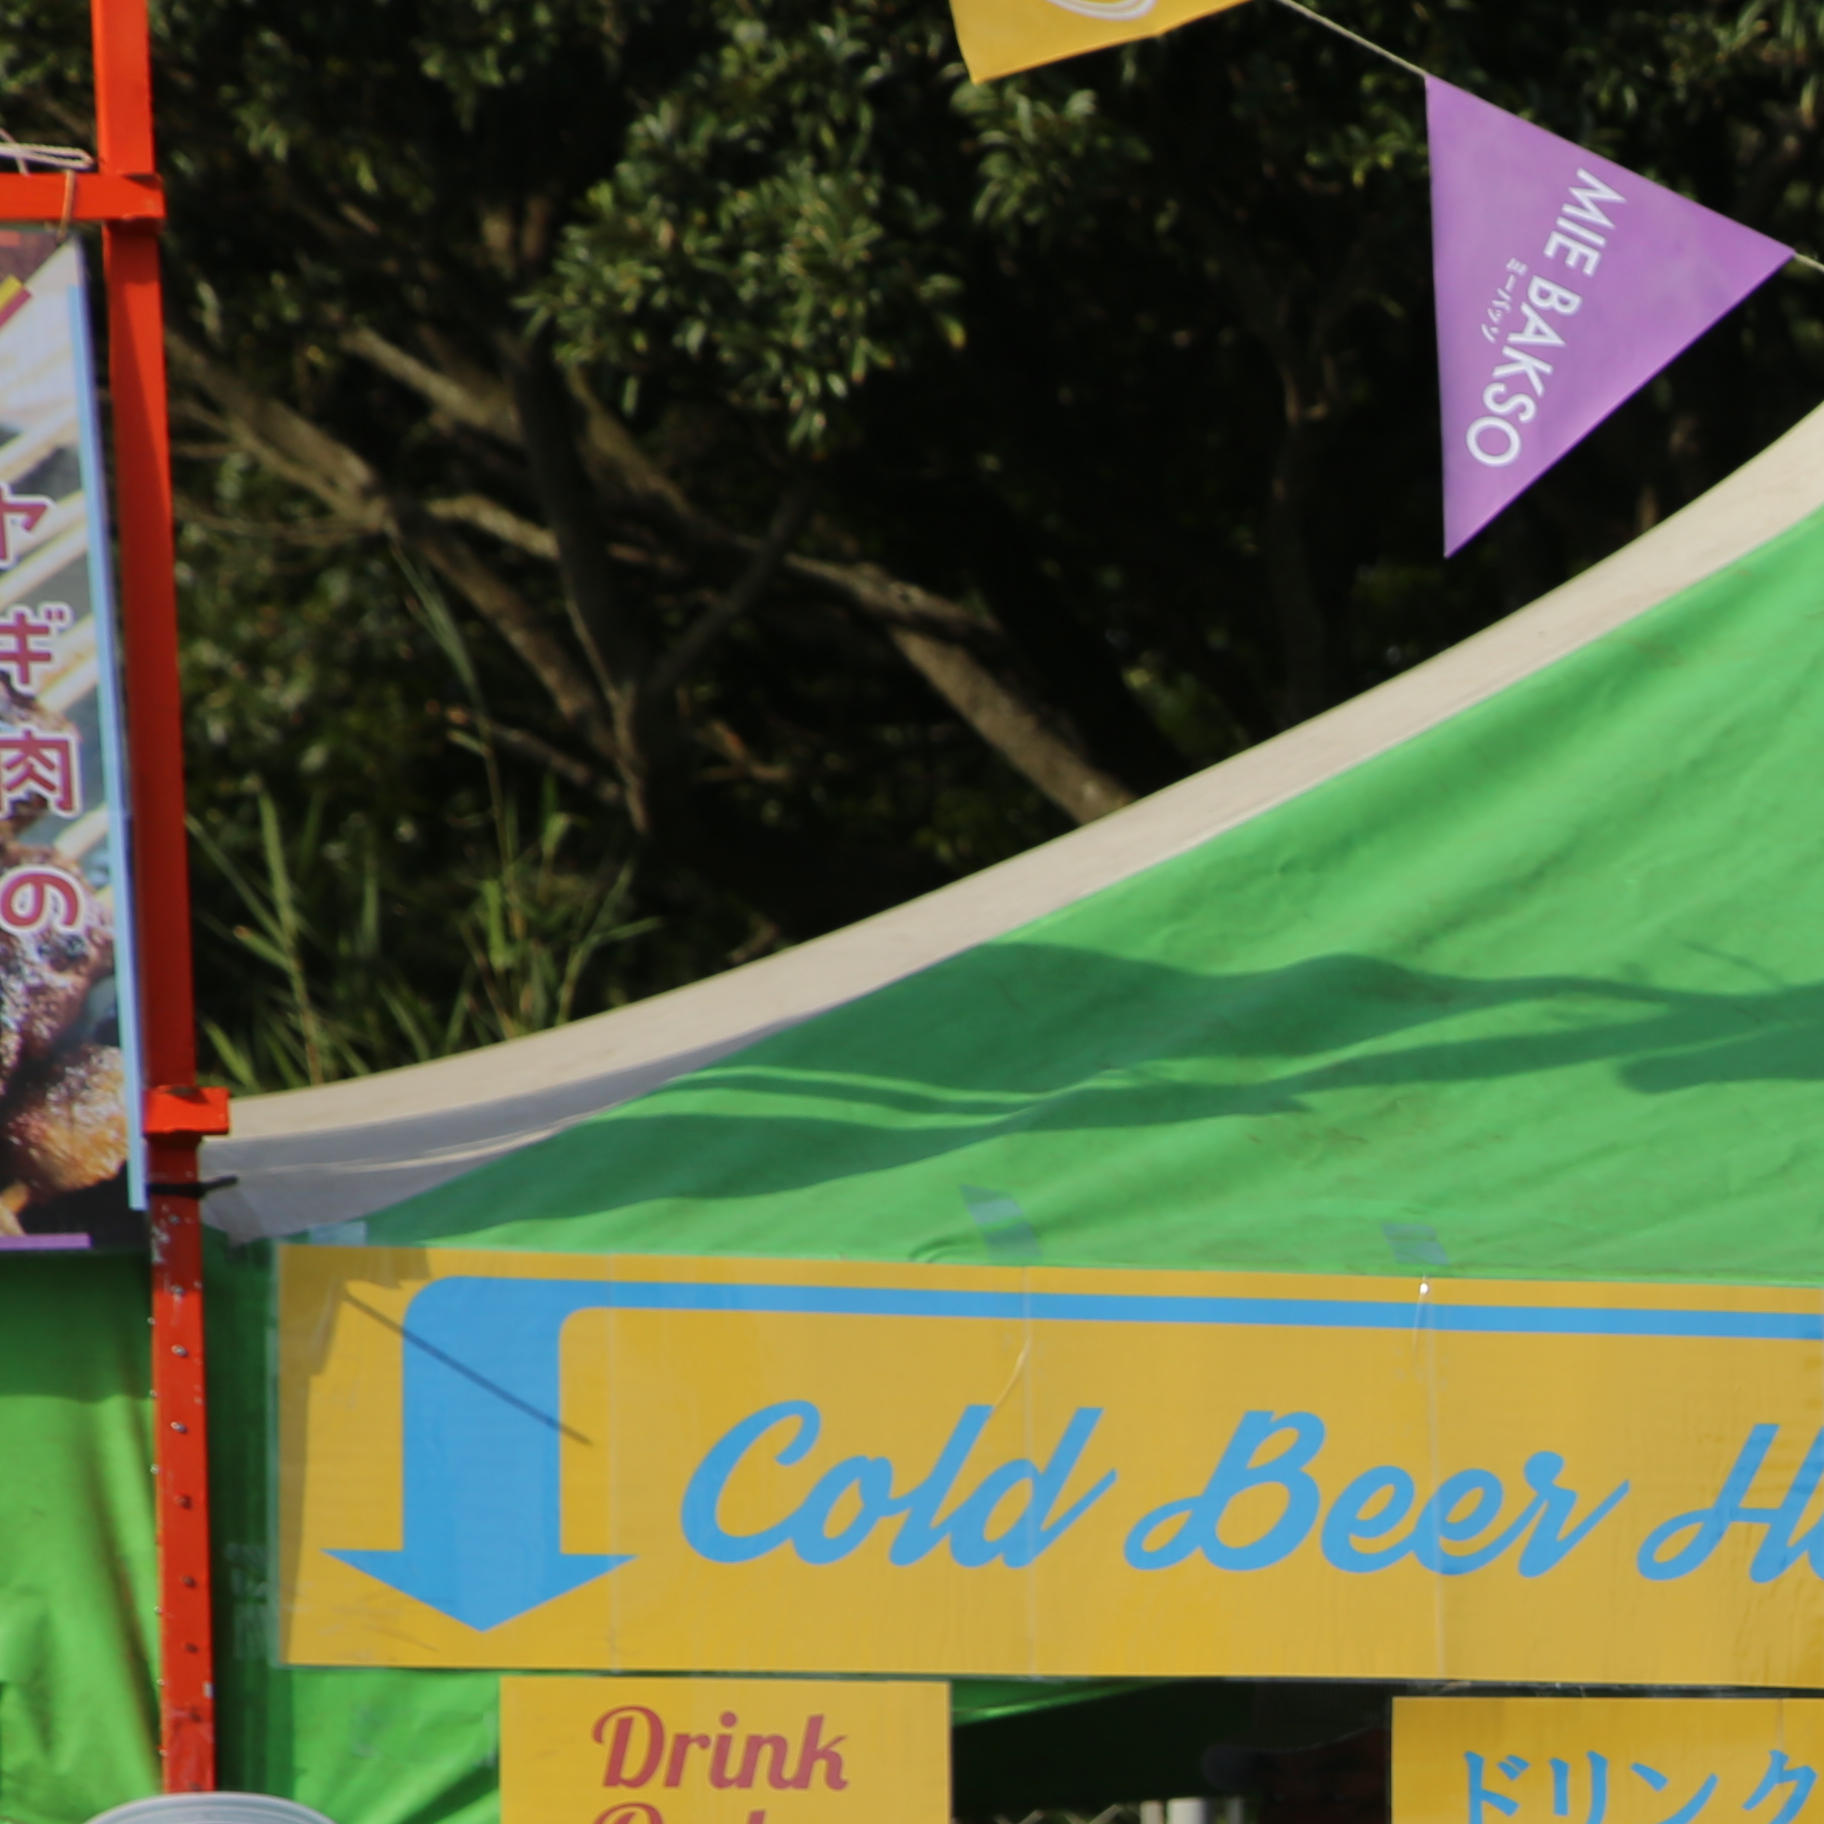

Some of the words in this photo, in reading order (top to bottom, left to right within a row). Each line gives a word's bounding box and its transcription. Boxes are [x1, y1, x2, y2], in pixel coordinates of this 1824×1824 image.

[1543, 166, 1628, 278] MIE
[1464, 274, 1584, 469] BAKSO
[680, 1400, 1118, 1568] Cold
[1122, 1410, 1630, 1577] Beer
[590, 1705, 849, 1791] Drink
